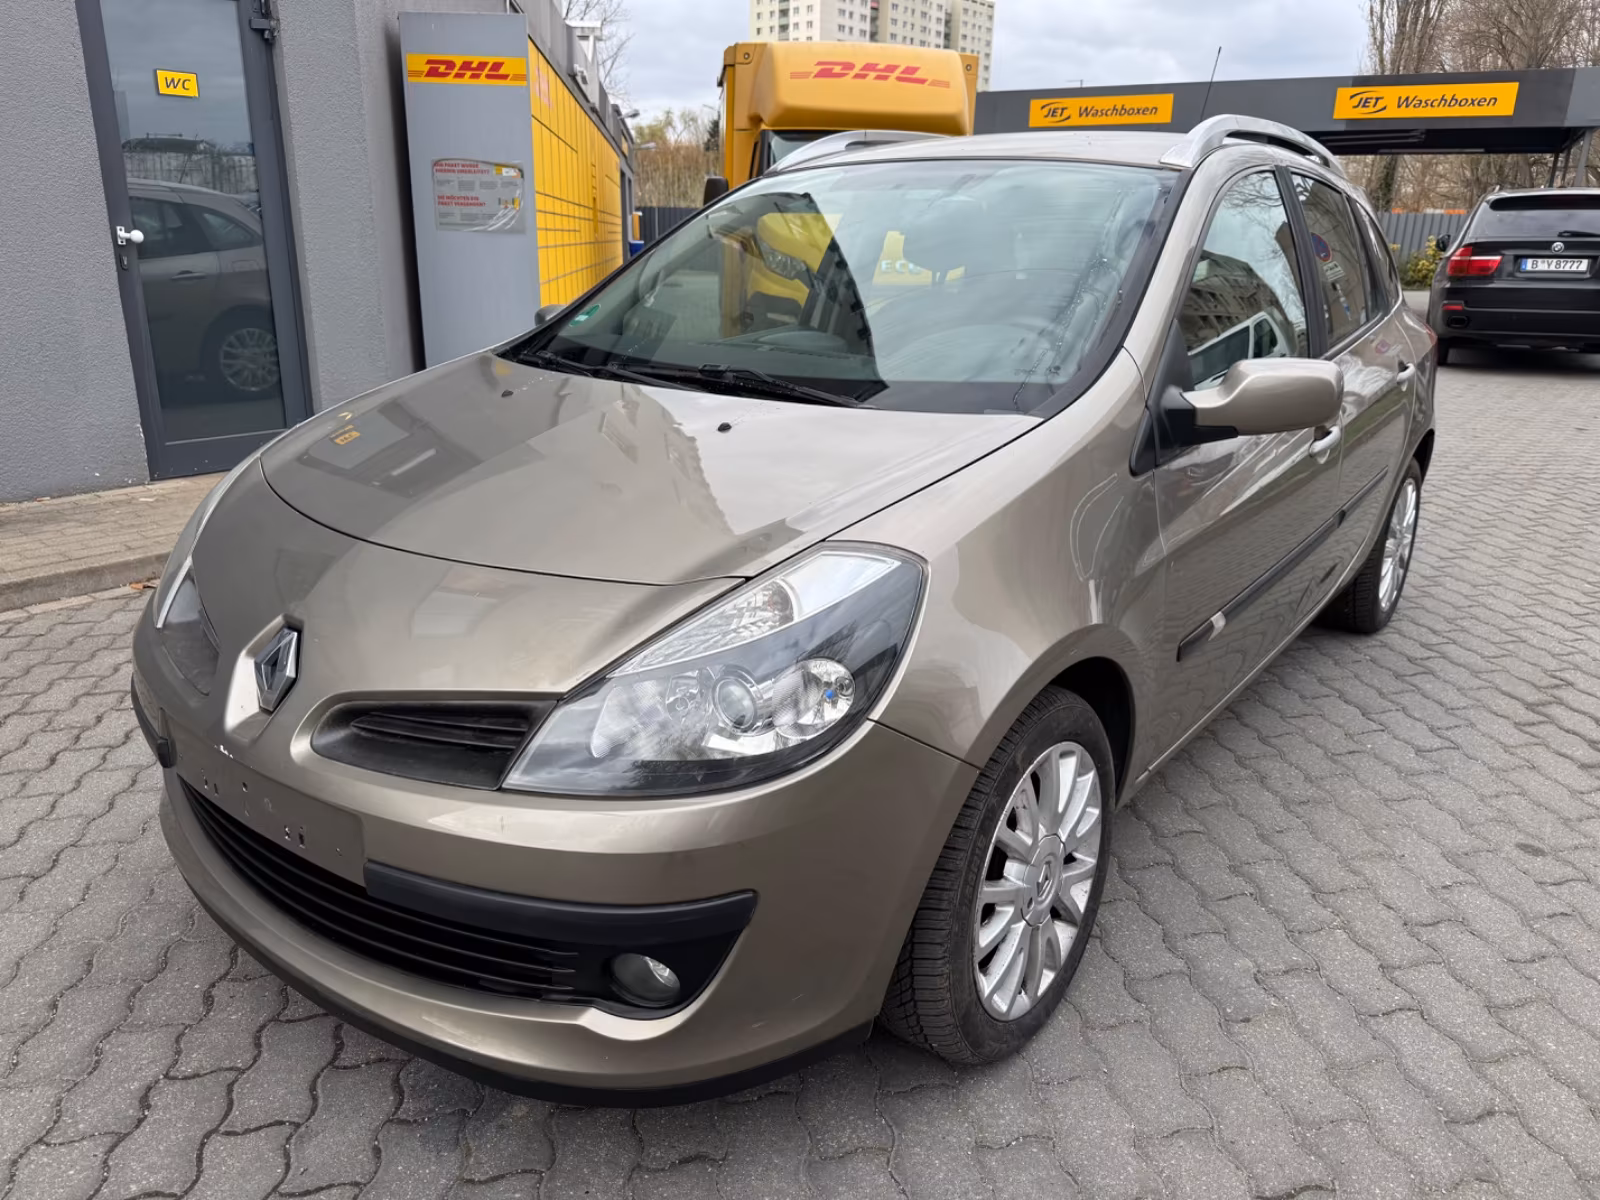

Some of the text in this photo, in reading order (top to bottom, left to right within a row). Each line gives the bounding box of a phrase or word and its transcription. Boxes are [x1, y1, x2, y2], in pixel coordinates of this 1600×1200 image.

[423, 59, 510, 80] DHL
[812, 60, 929, 85] DHL
[164, 76, 192, 91] WC
[1352, 94, 1498, 109] JET Waschboxen
[1043, 104, 1159, 118] JET Waschboxen
[1531, 259, 1539, 270] B
[1555, 259, 1583, 270] 8777
